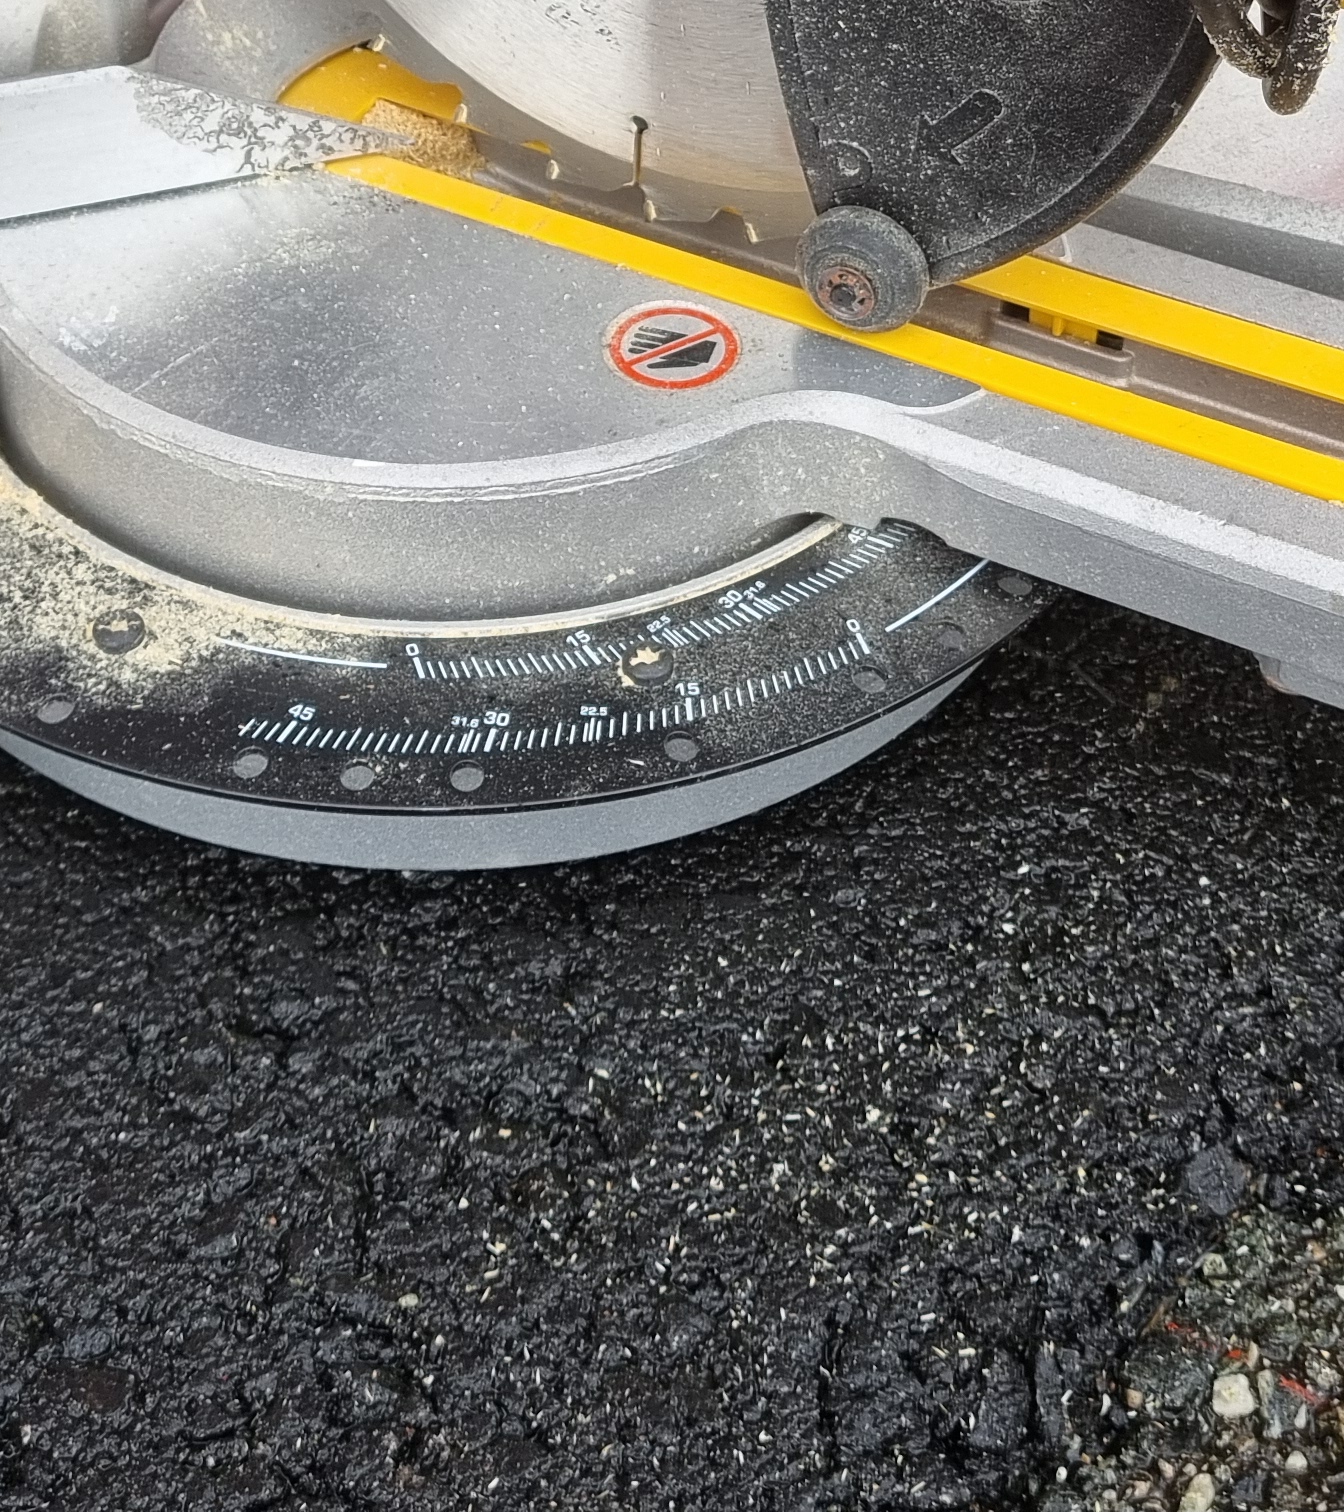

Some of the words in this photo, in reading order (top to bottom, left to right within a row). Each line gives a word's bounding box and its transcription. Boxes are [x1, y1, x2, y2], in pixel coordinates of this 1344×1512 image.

[405, 643, 420, 657] 0
[565, 629, 591, 647] 15
[646, 615, 671, 633] 22.5
[718, 589, 743, 609] 30
[847, 526, 868, 544] 45
[288, 703, 316, 721] 45
[451, 715, 480, 729] 31.6
[483, 710, 510, 727] 30
[580, 706, 607, 716] 22.5
[674, 682, 700, 696] 15
[846, 618, 861, 633] 0
